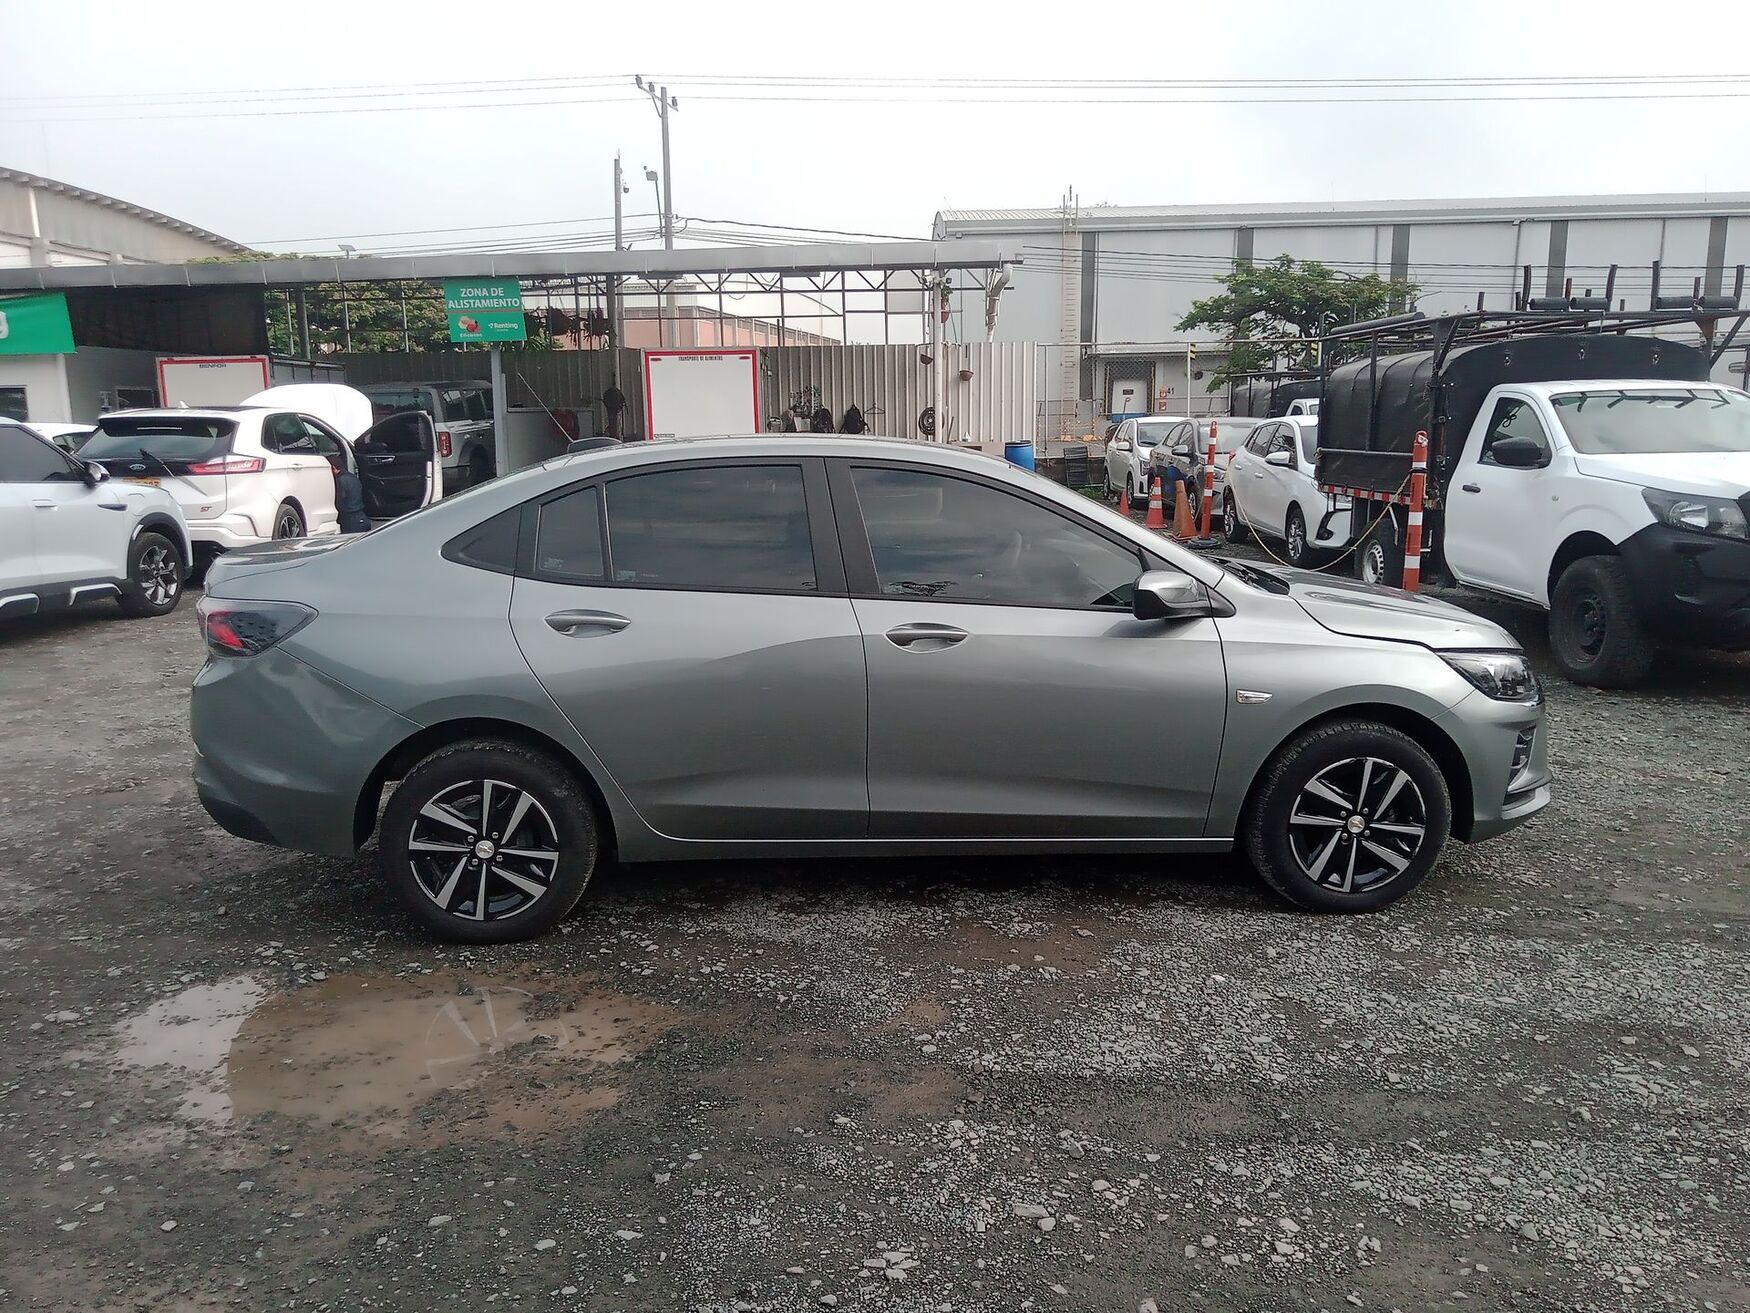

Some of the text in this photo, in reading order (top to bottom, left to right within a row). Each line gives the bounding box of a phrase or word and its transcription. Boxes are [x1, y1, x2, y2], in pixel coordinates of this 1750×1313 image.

[460, 287, 505, 297] ZONA DE
[448, 298, 520, 309] ALISTAMIENTO
[494, 321, 519, 330] Renting
